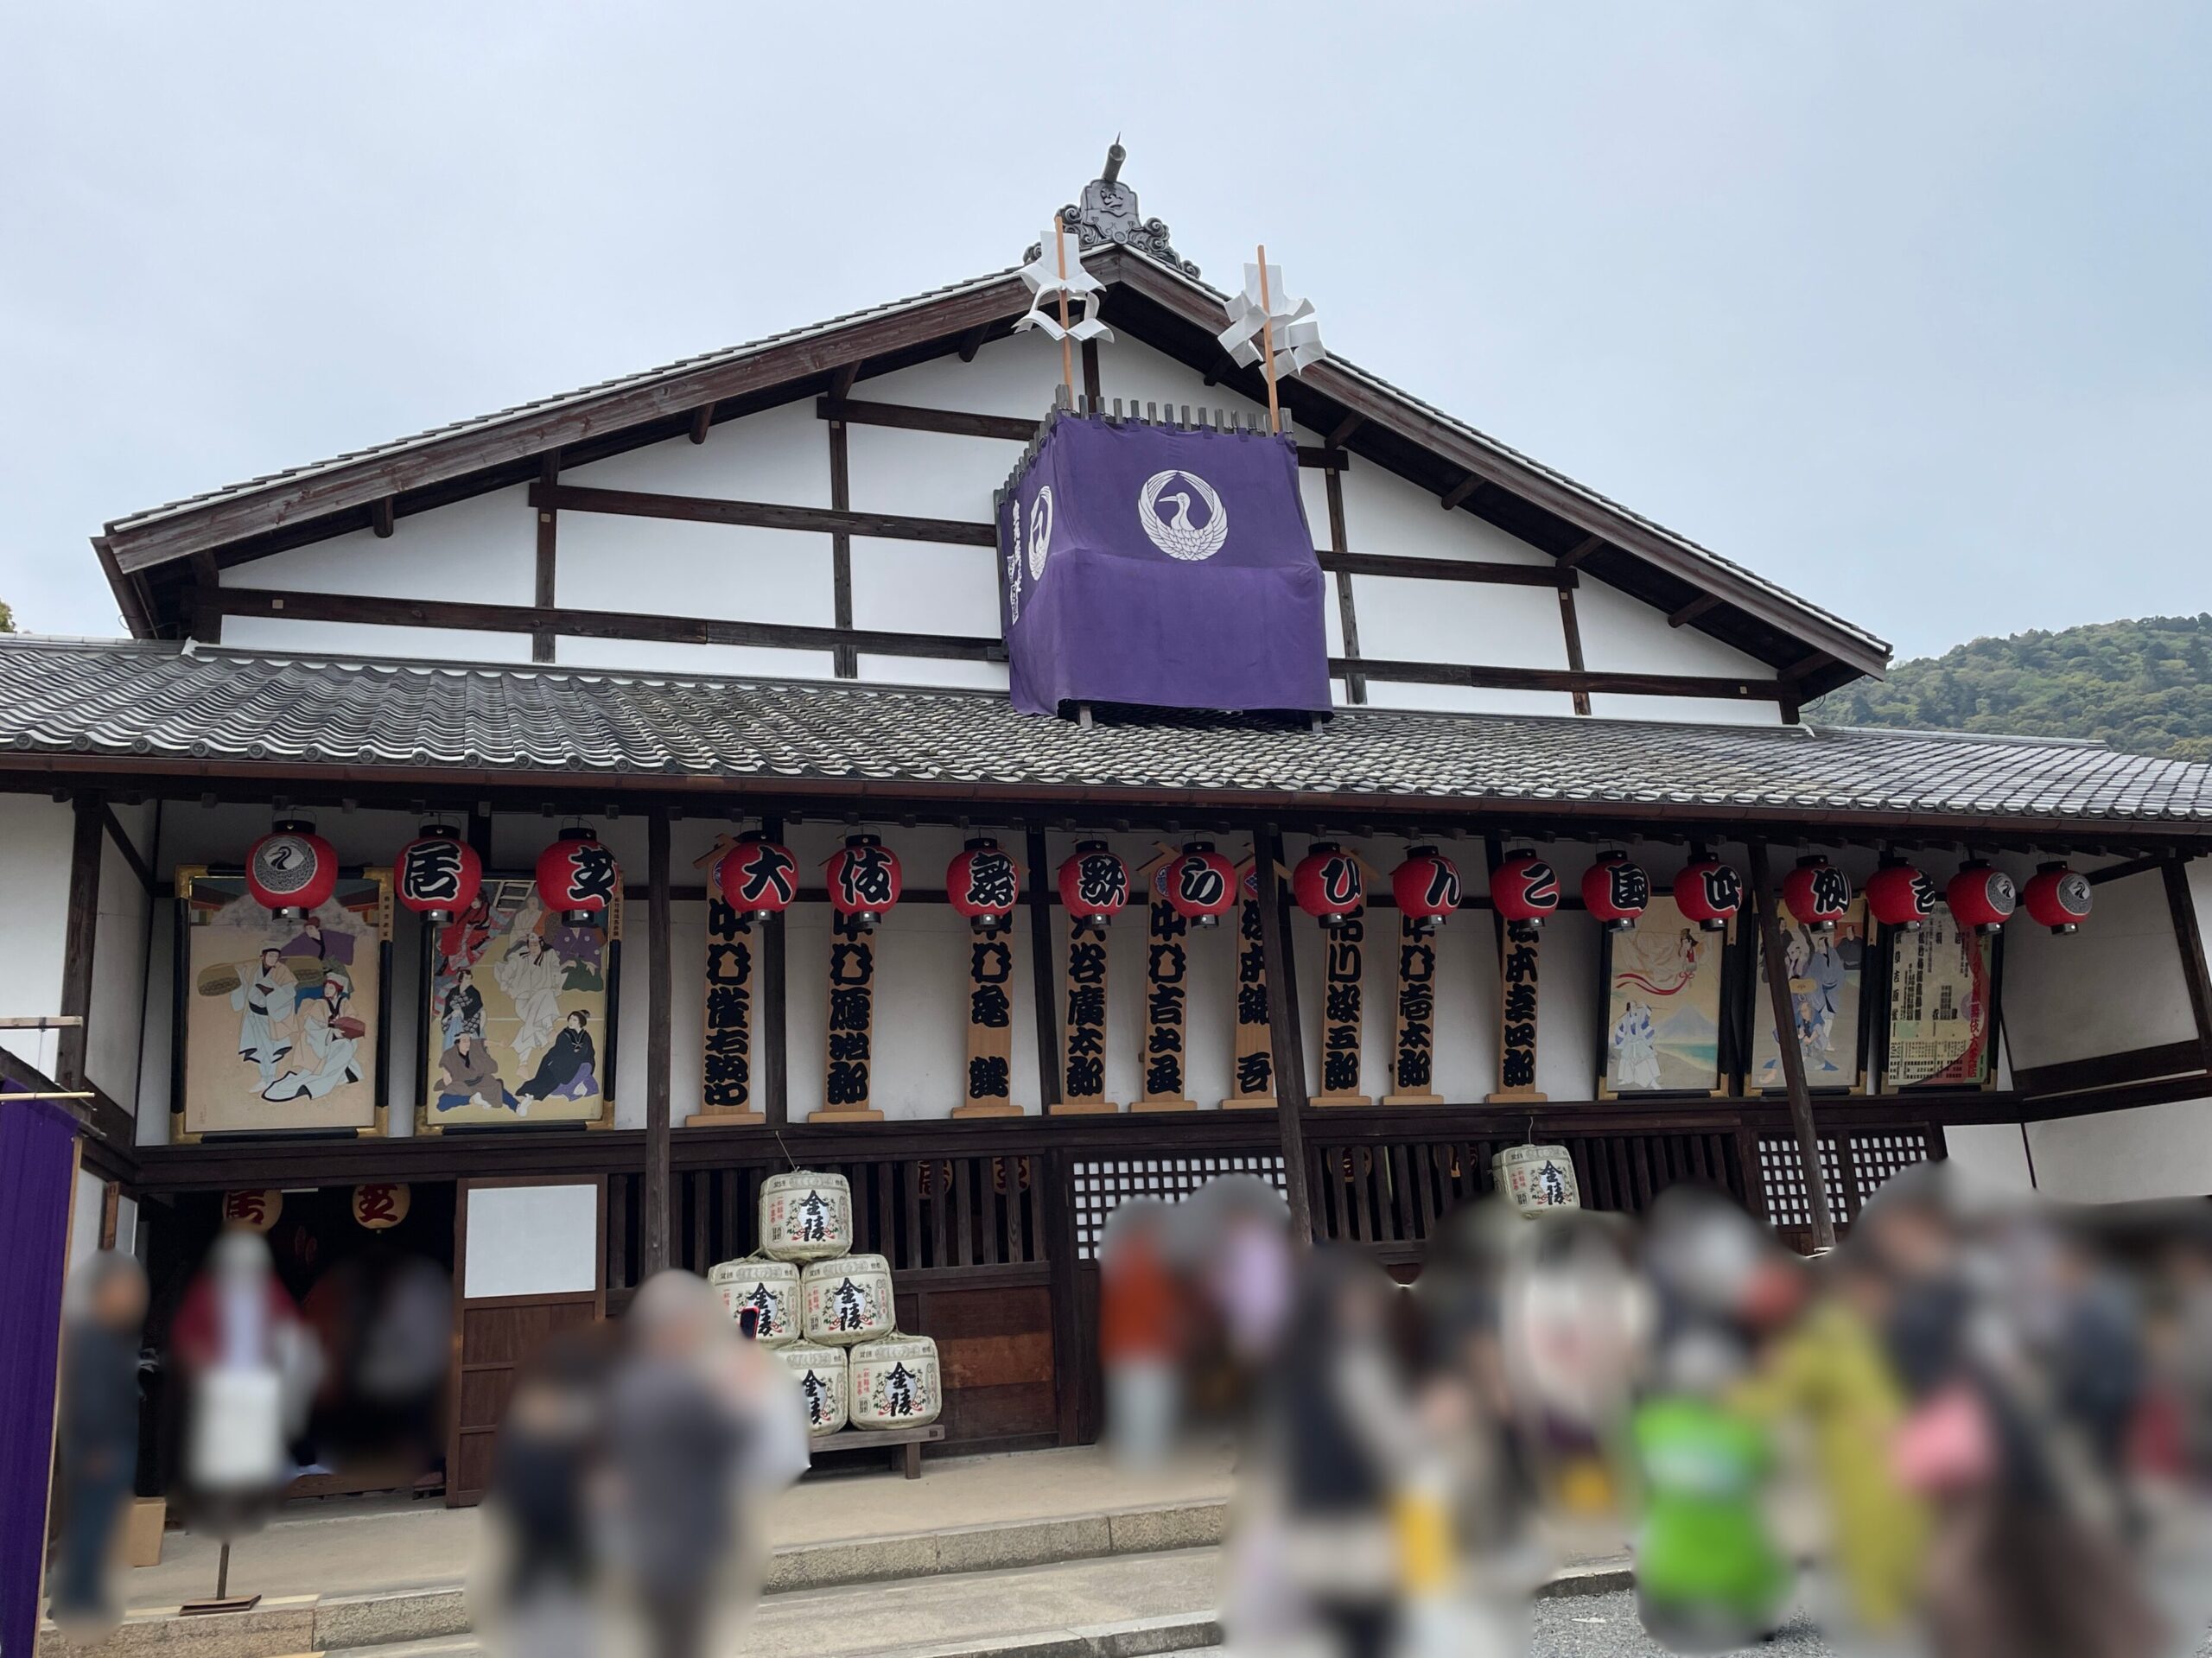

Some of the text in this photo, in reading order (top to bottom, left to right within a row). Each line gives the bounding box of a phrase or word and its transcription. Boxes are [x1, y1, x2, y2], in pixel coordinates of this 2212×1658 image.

[404, 839, 461, 901] 居
[567, 844, 619, 907] 芝
[739, 845, 795, 904] 大
[839, 846, 892, 905] 伎
[966, 850, 1016, 908] 舞
[1077, 853, 1128, 907] 歌
[1179, 855, 1228, 906] ら
[1320, 855, 1363, 905] ひ
[1425, 857, 1464, 909] ん
[1520, 861, 1560, 909] こ
[1702, 864, 1743, 913] 四
